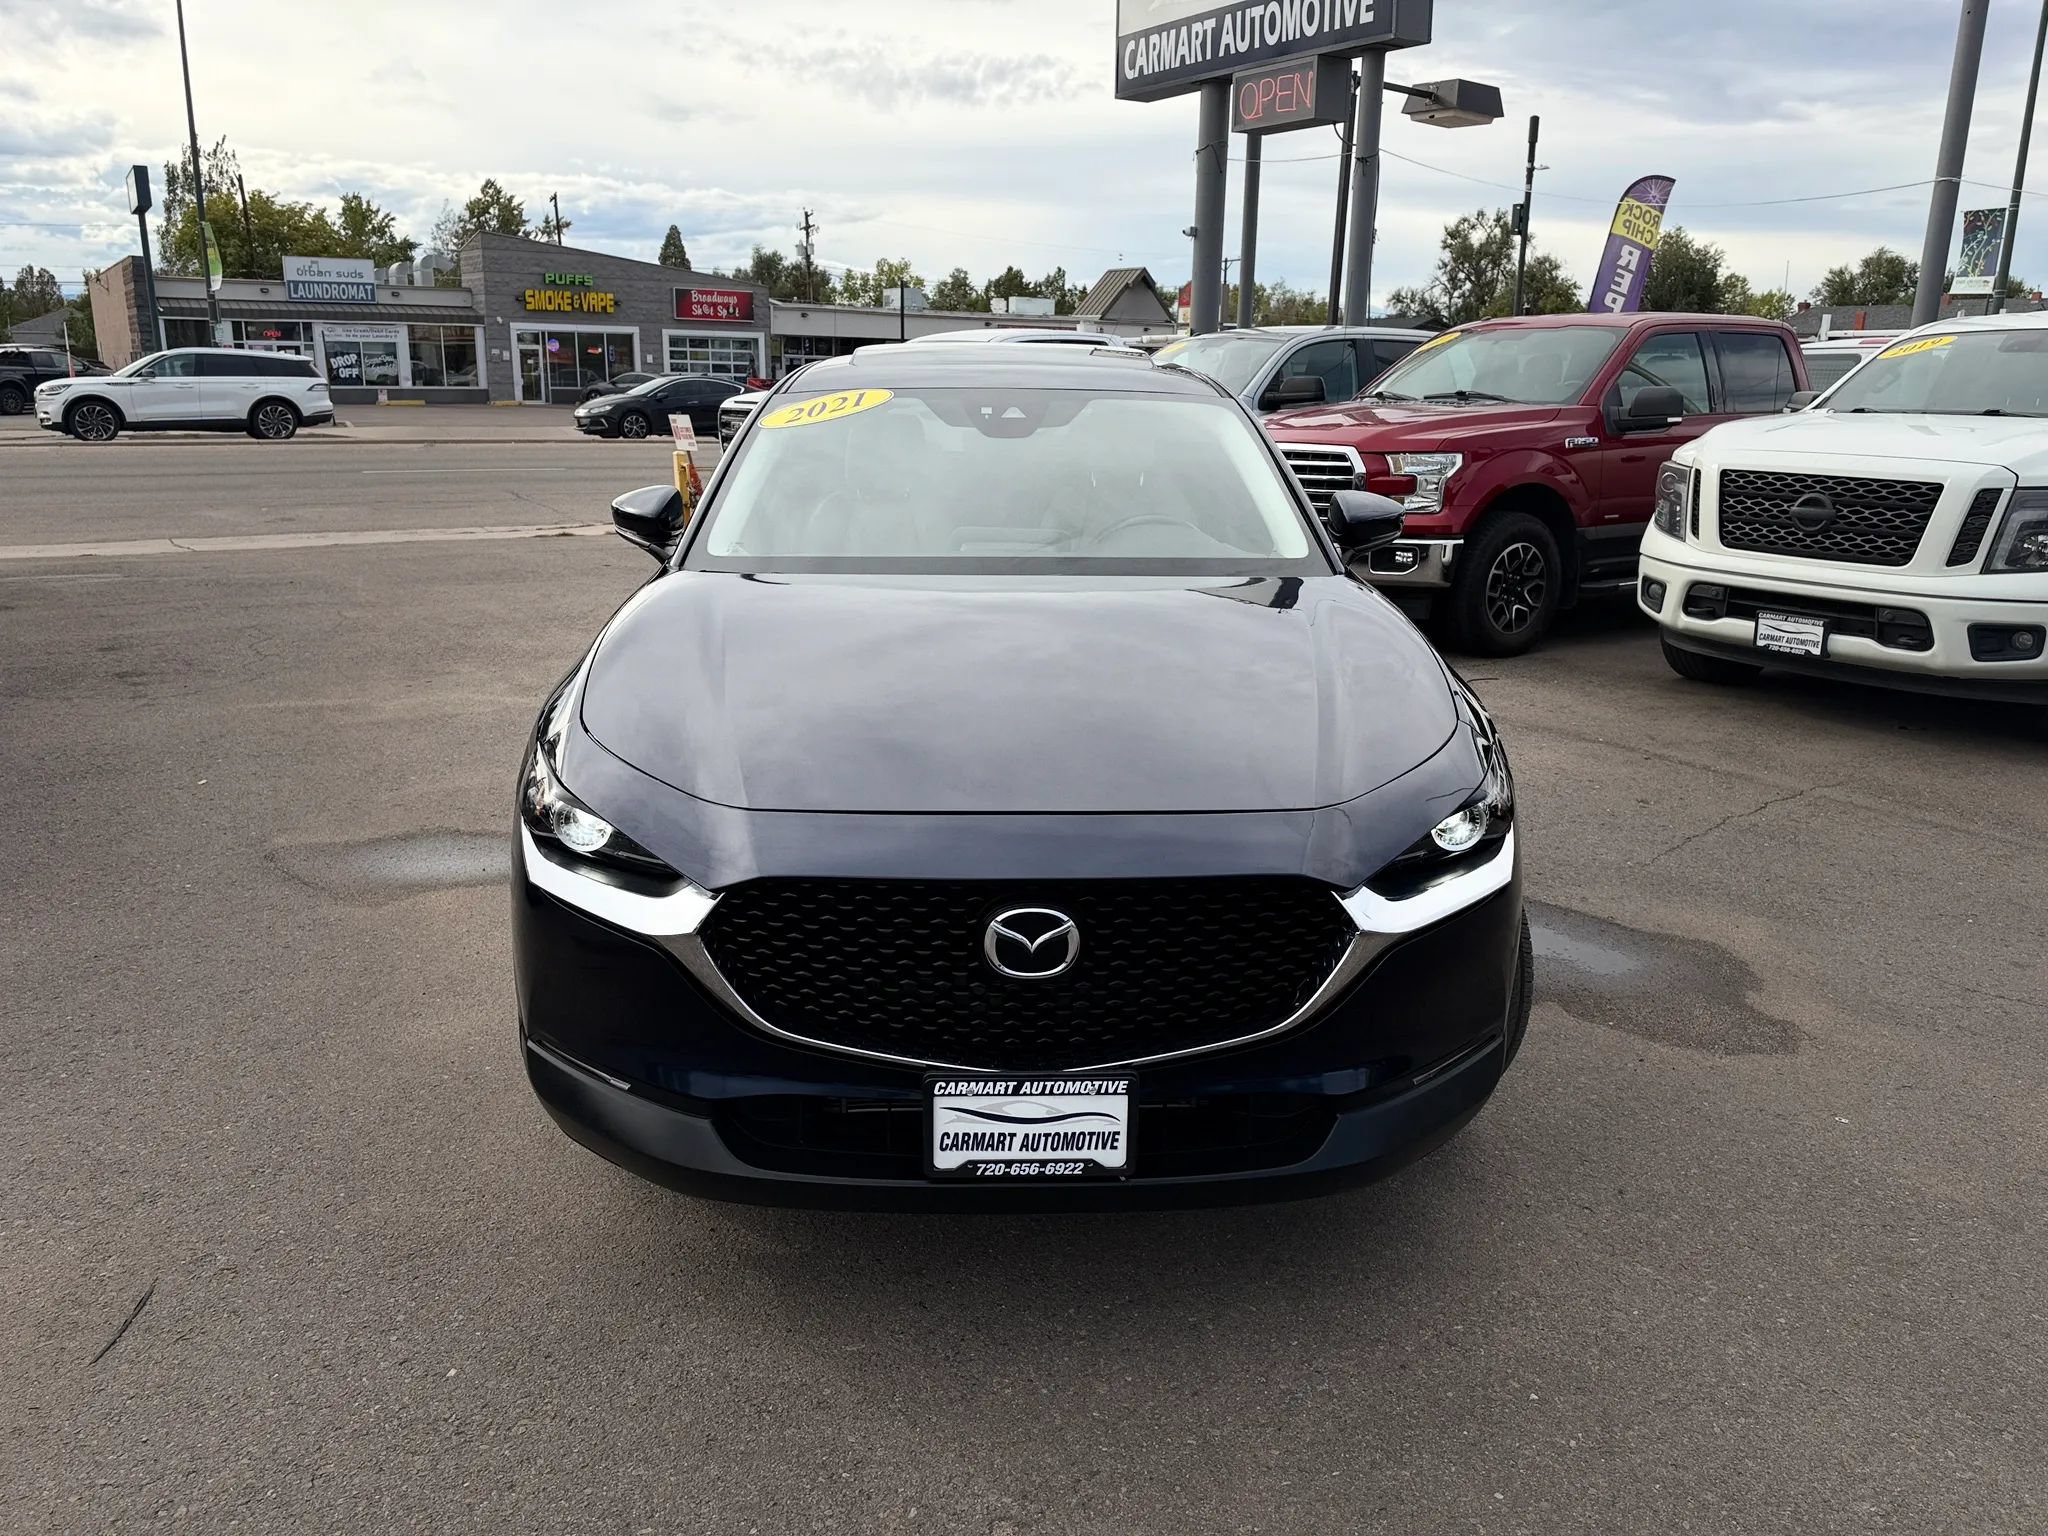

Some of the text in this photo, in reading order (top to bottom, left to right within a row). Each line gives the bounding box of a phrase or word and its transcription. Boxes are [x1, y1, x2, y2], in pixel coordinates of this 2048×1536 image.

[1124, 0, 1375, 80] CARMART AUTOMOTIVE
[1239, 71, 1314, 121] OPEN
[336, 269, 364, 279] suds
[544, 272, 594, 286] PUFFS
[290, 281, 373, 300] LAUNDROMAT
[691, 290, 738, 304] Broadways
[524, 289, 615, 313] SMOKE & VAPE
[263, 329, 281, 338] OPEN
[329, 353, 358, 369] DROP
[338, 367, 359, 378] OFF
[785, 391, 866, 424] 2021
[1758, 612, 1824, 627] CARMART AUTOMOTIVE
[1758, 633, 1820, 649] CARMART AUTOMOTIVE
[933, 1080, 1128, 1095] CARMART AUTOMOTIVE
[939, 1131, 1121, 1152] CARMART AUTOMOTIVE
[975, 1162, 1084, 1176] 720-656-6922
